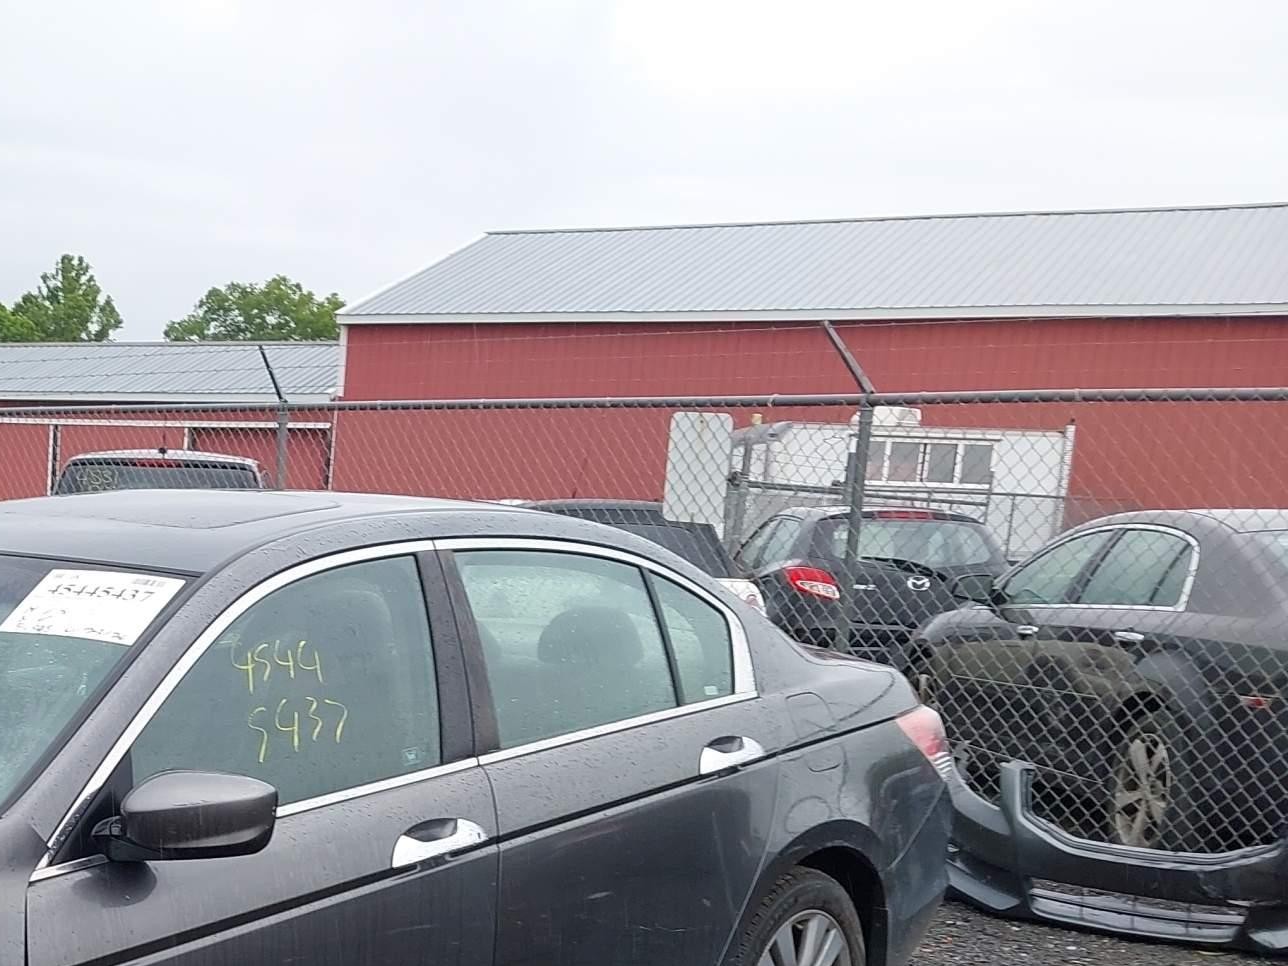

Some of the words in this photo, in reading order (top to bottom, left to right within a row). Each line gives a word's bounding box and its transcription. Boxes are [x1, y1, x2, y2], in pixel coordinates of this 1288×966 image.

[48, 584, 155, 602] 45445437
[231, 640, 324, 694] 4544
[248, 697, 348, 763] 5437
